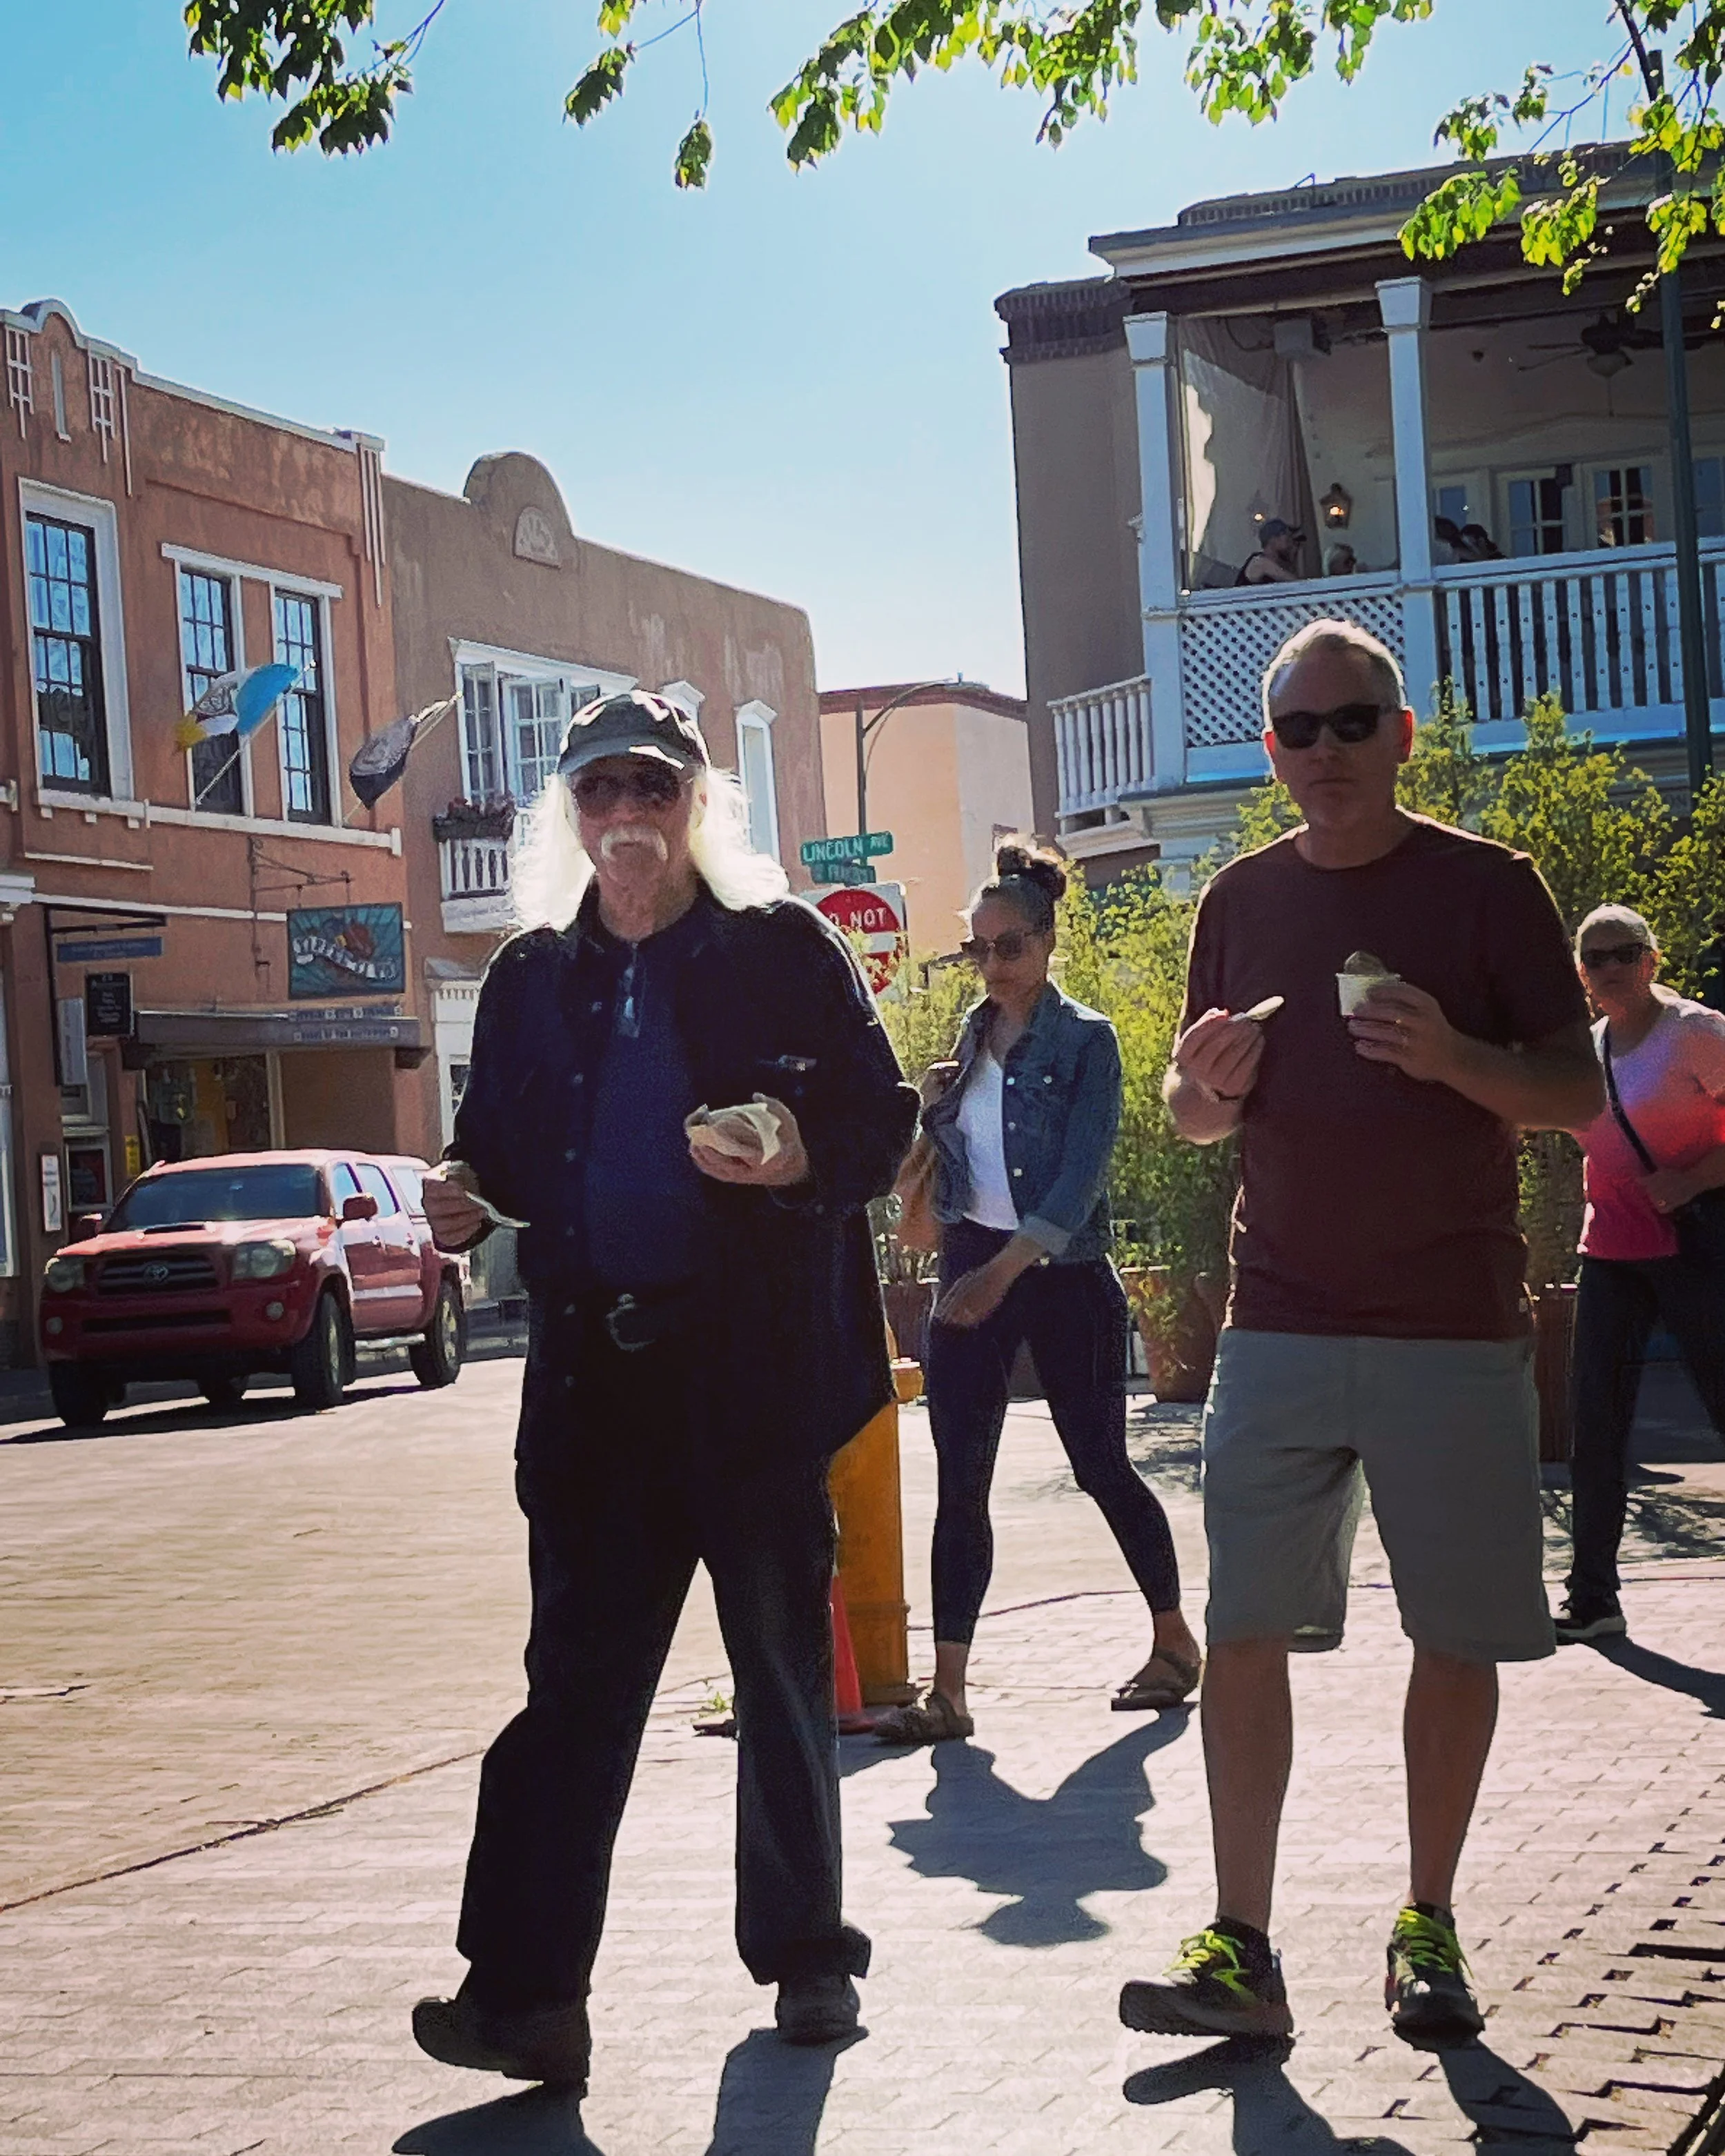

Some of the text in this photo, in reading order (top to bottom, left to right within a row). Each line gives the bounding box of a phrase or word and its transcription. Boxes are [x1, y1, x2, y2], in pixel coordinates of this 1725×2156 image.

[802, 837, 865, 862] LINCOLN
[828, 907, 887, 928] O NOT
